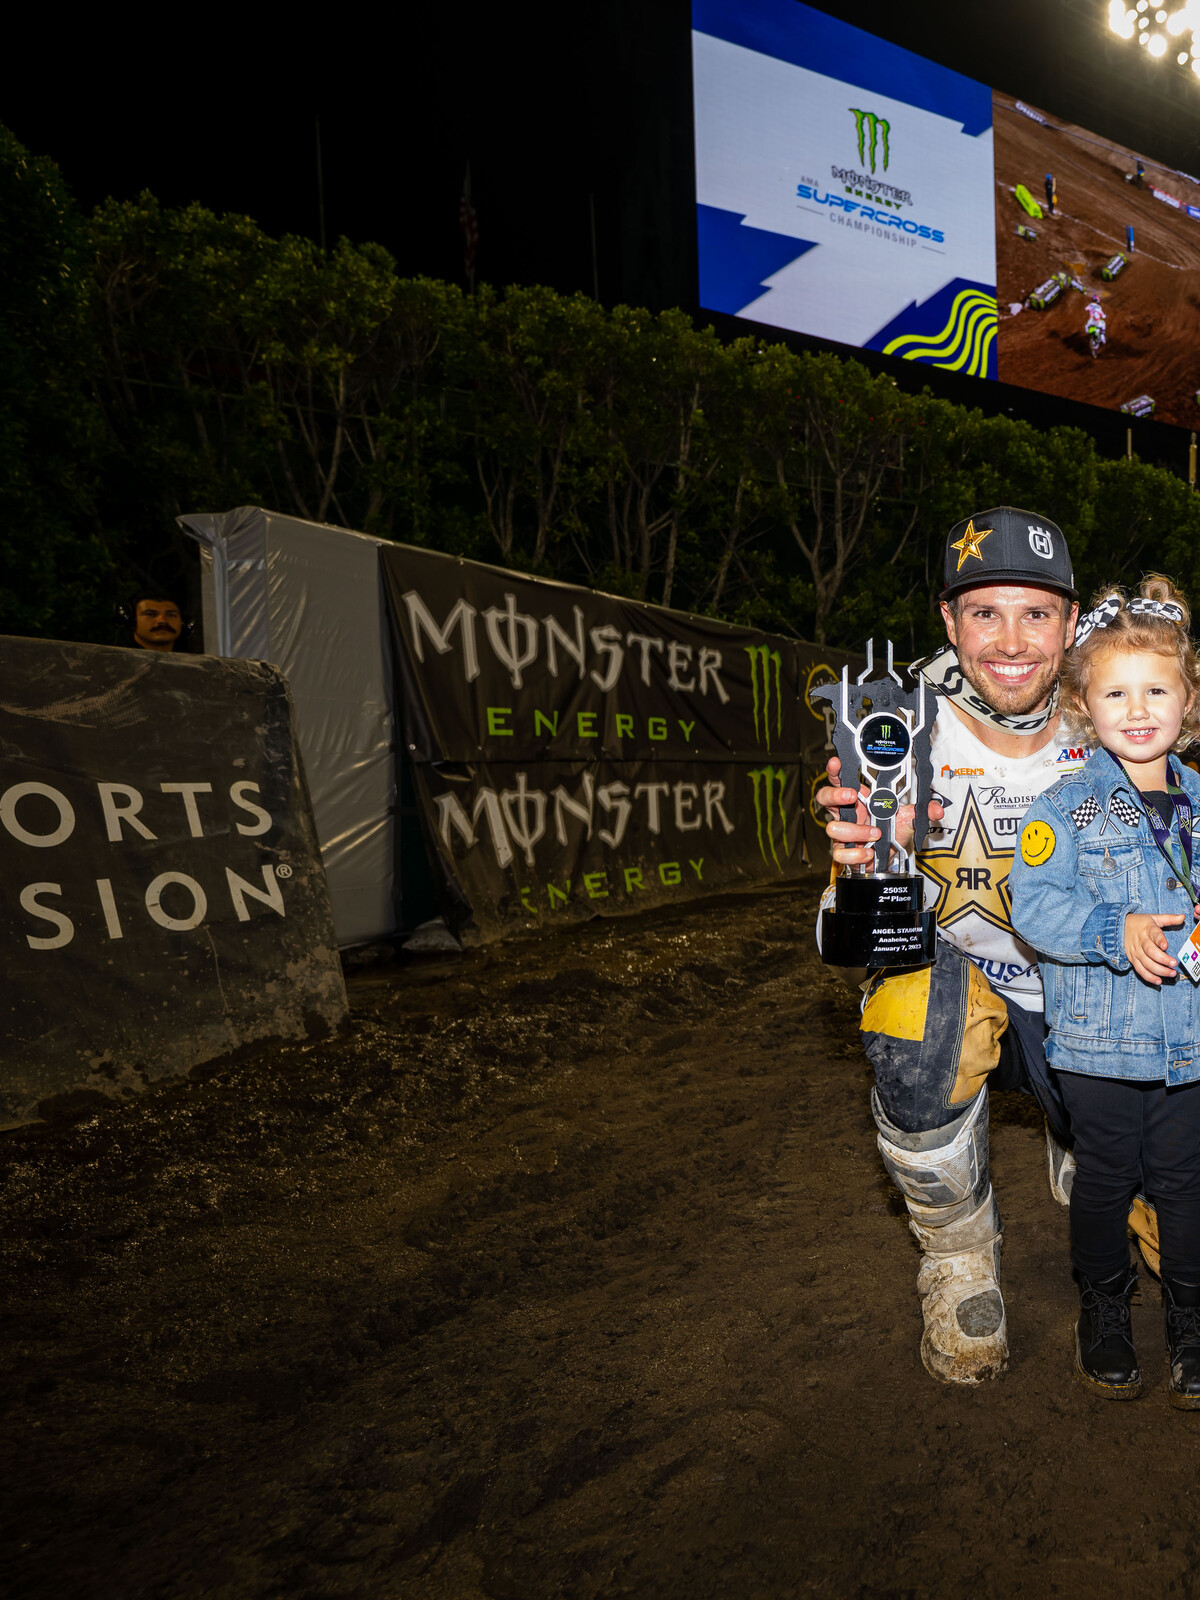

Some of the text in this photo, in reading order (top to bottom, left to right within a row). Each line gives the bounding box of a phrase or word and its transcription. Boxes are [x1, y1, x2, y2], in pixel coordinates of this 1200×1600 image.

[801, 176, 819, 188] AMA
[831, 165, 913, 206] MONSTER
[845, 186, 902, 210] ENERGY
[796, 184, 945, 243] SUPERCROSS
[829, 212, 917, 248] CHAMPIONSHIP
[401, 590, 731, 706] MONSTER
[486, 706, 697, 743] ENERGY
[963, 695, 1050, 730] SCO
[954, 767, 985, 776] KEEN'S
[0, 780, 273, 848] ORTS
[432, 762, 736, 869] MONSTER
[878, 895, 890, 903] 2nd
[882, 886, 908, 894] 250SX
[897, 926, 923, 934] STADIUM
[873, 945, 900, 953] January
